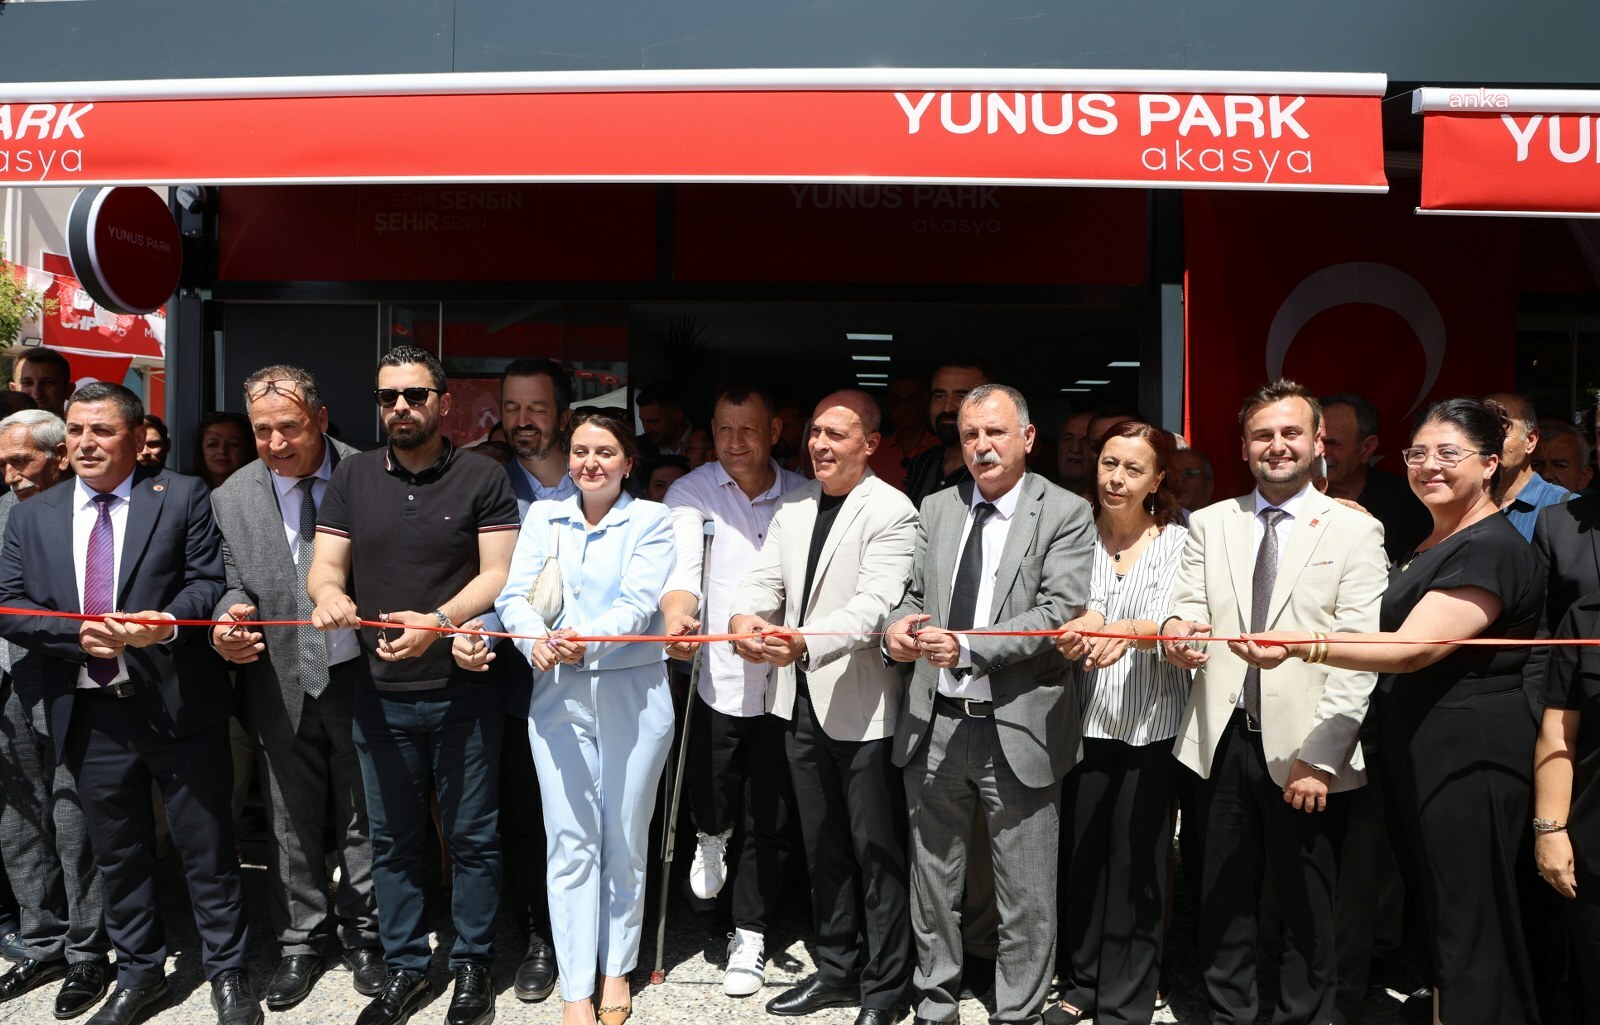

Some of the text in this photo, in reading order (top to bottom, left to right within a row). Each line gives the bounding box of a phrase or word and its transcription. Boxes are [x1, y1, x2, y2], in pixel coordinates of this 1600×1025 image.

[893, 91, 1310, 139] YUNUS PARK
[1500, 114, 1600, 164] YU
[1141, 140, 1313, 183] akasya
[788, 185, 1001, 209] YUNUS PARK
[107, 224, 172, 255] YUNUS PARK
[912, 215, 1001, 237] akasya
